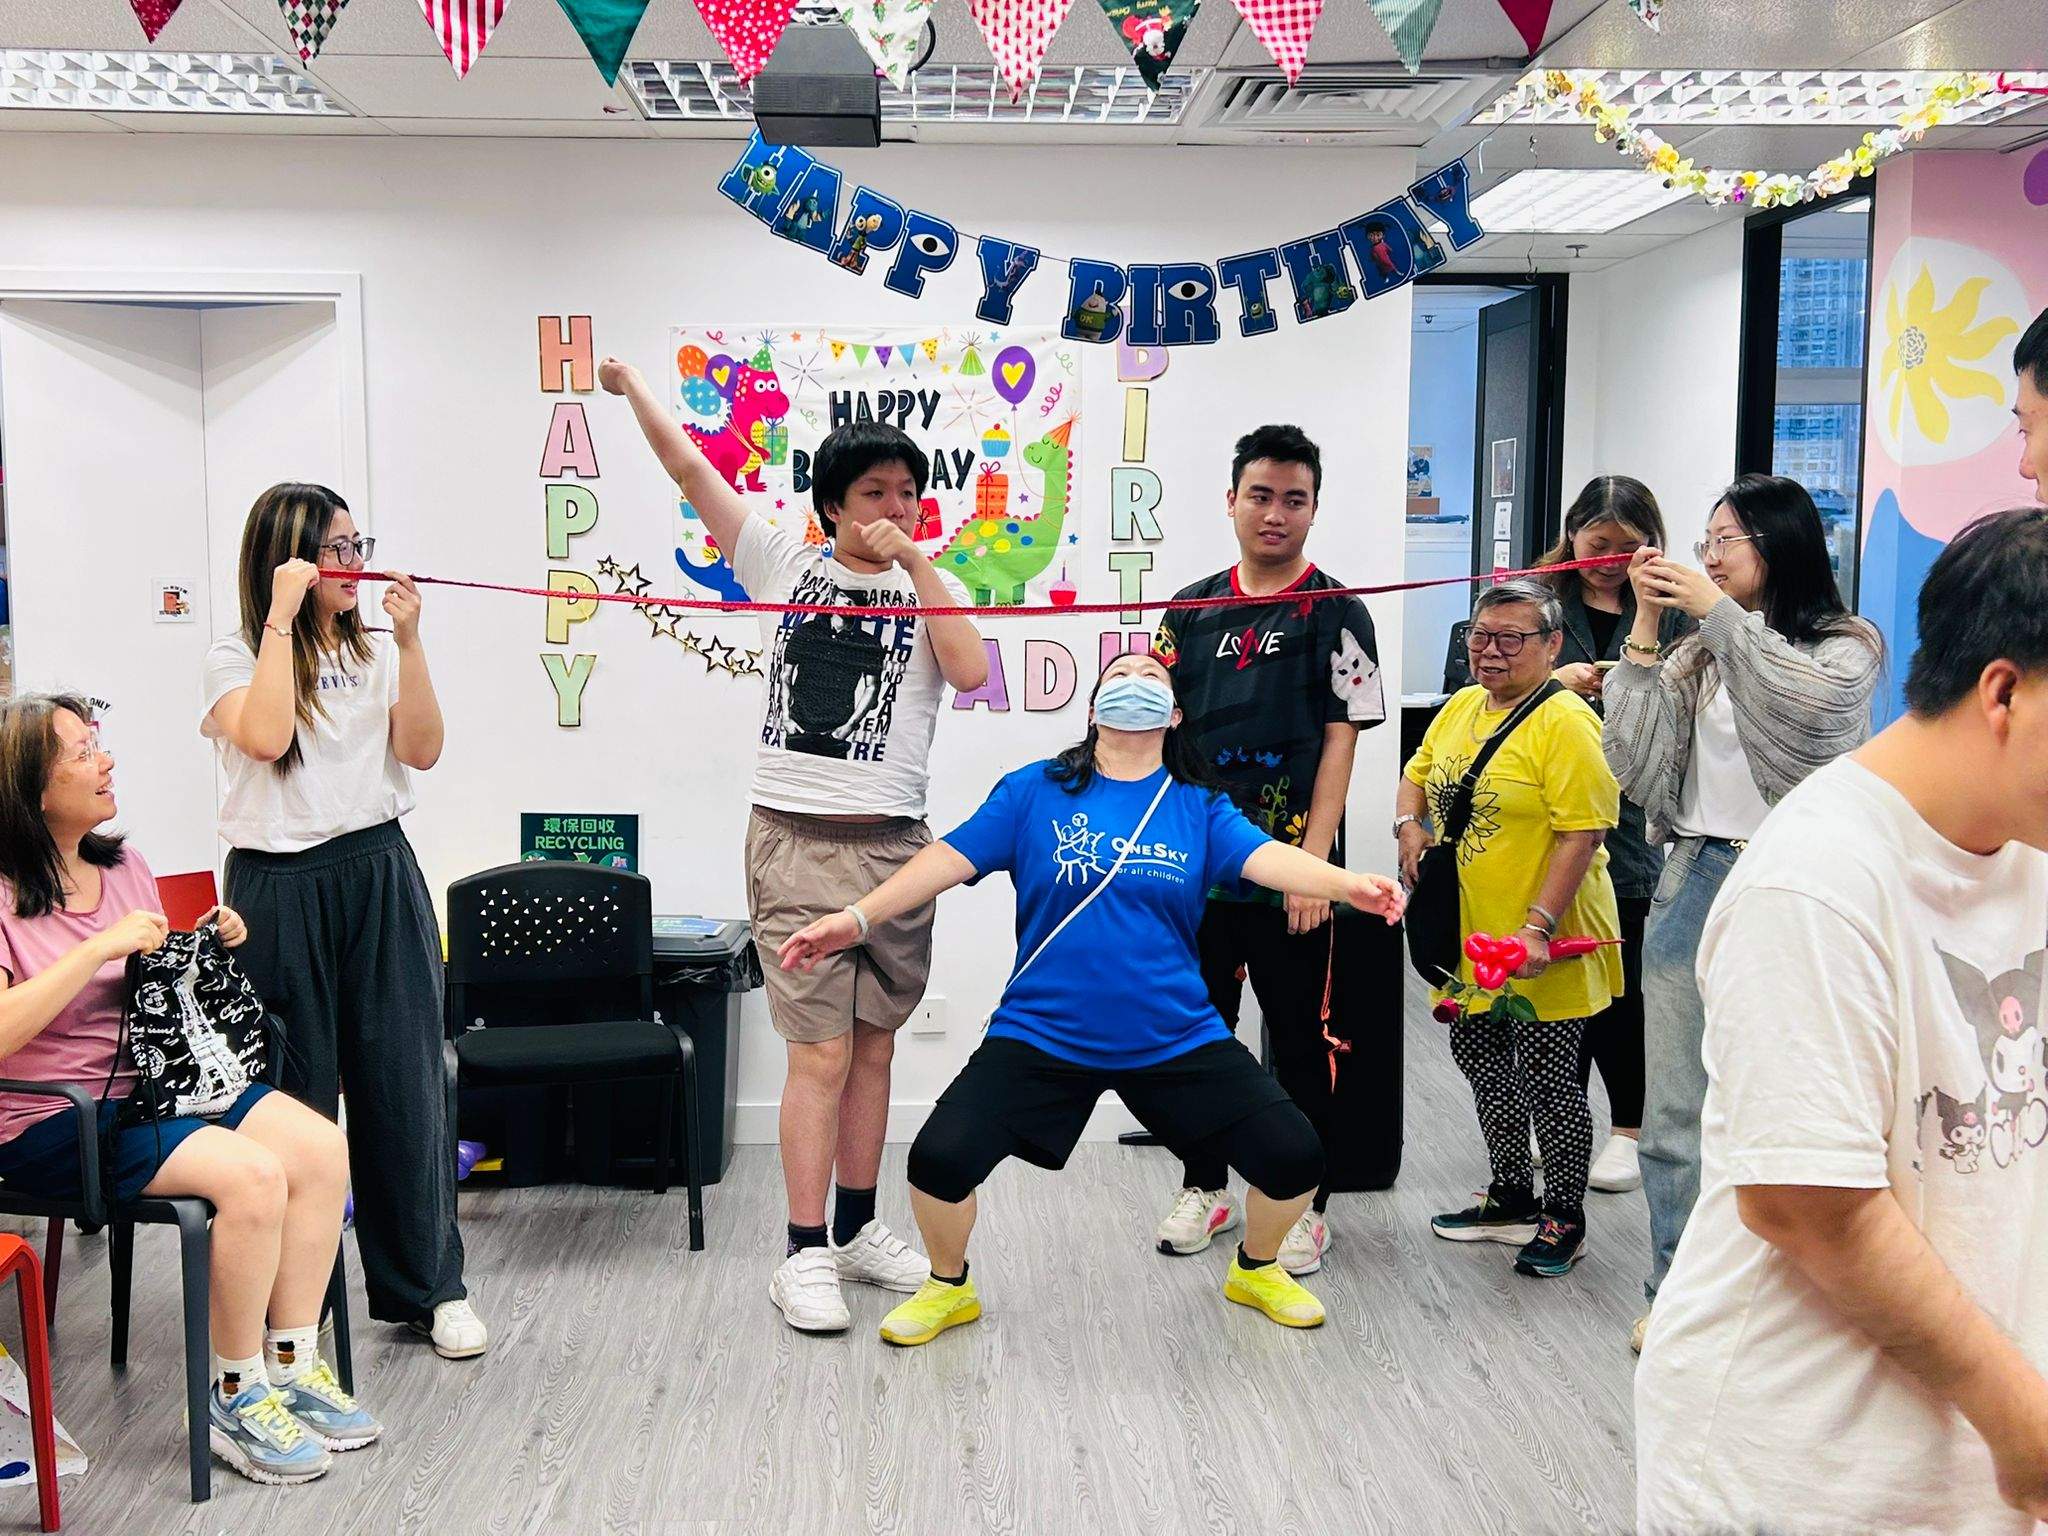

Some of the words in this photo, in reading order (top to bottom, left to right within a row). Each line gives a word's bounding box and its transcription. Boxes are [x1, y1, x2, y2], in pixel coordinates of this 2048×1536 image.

[717, 129, 1041, 327] HAPPY
[829, 388, 941, 431] HAPPY
[538, 315, 600, 727] HAPPY
[90, 697, 111, 711] ONLY
[543, 817, 616, 834] 環保回收
[535, 835, 625, 850] RECYCLING
[1131, 867, 1143, 875] all
[1147, 869, 1185, 885] children
